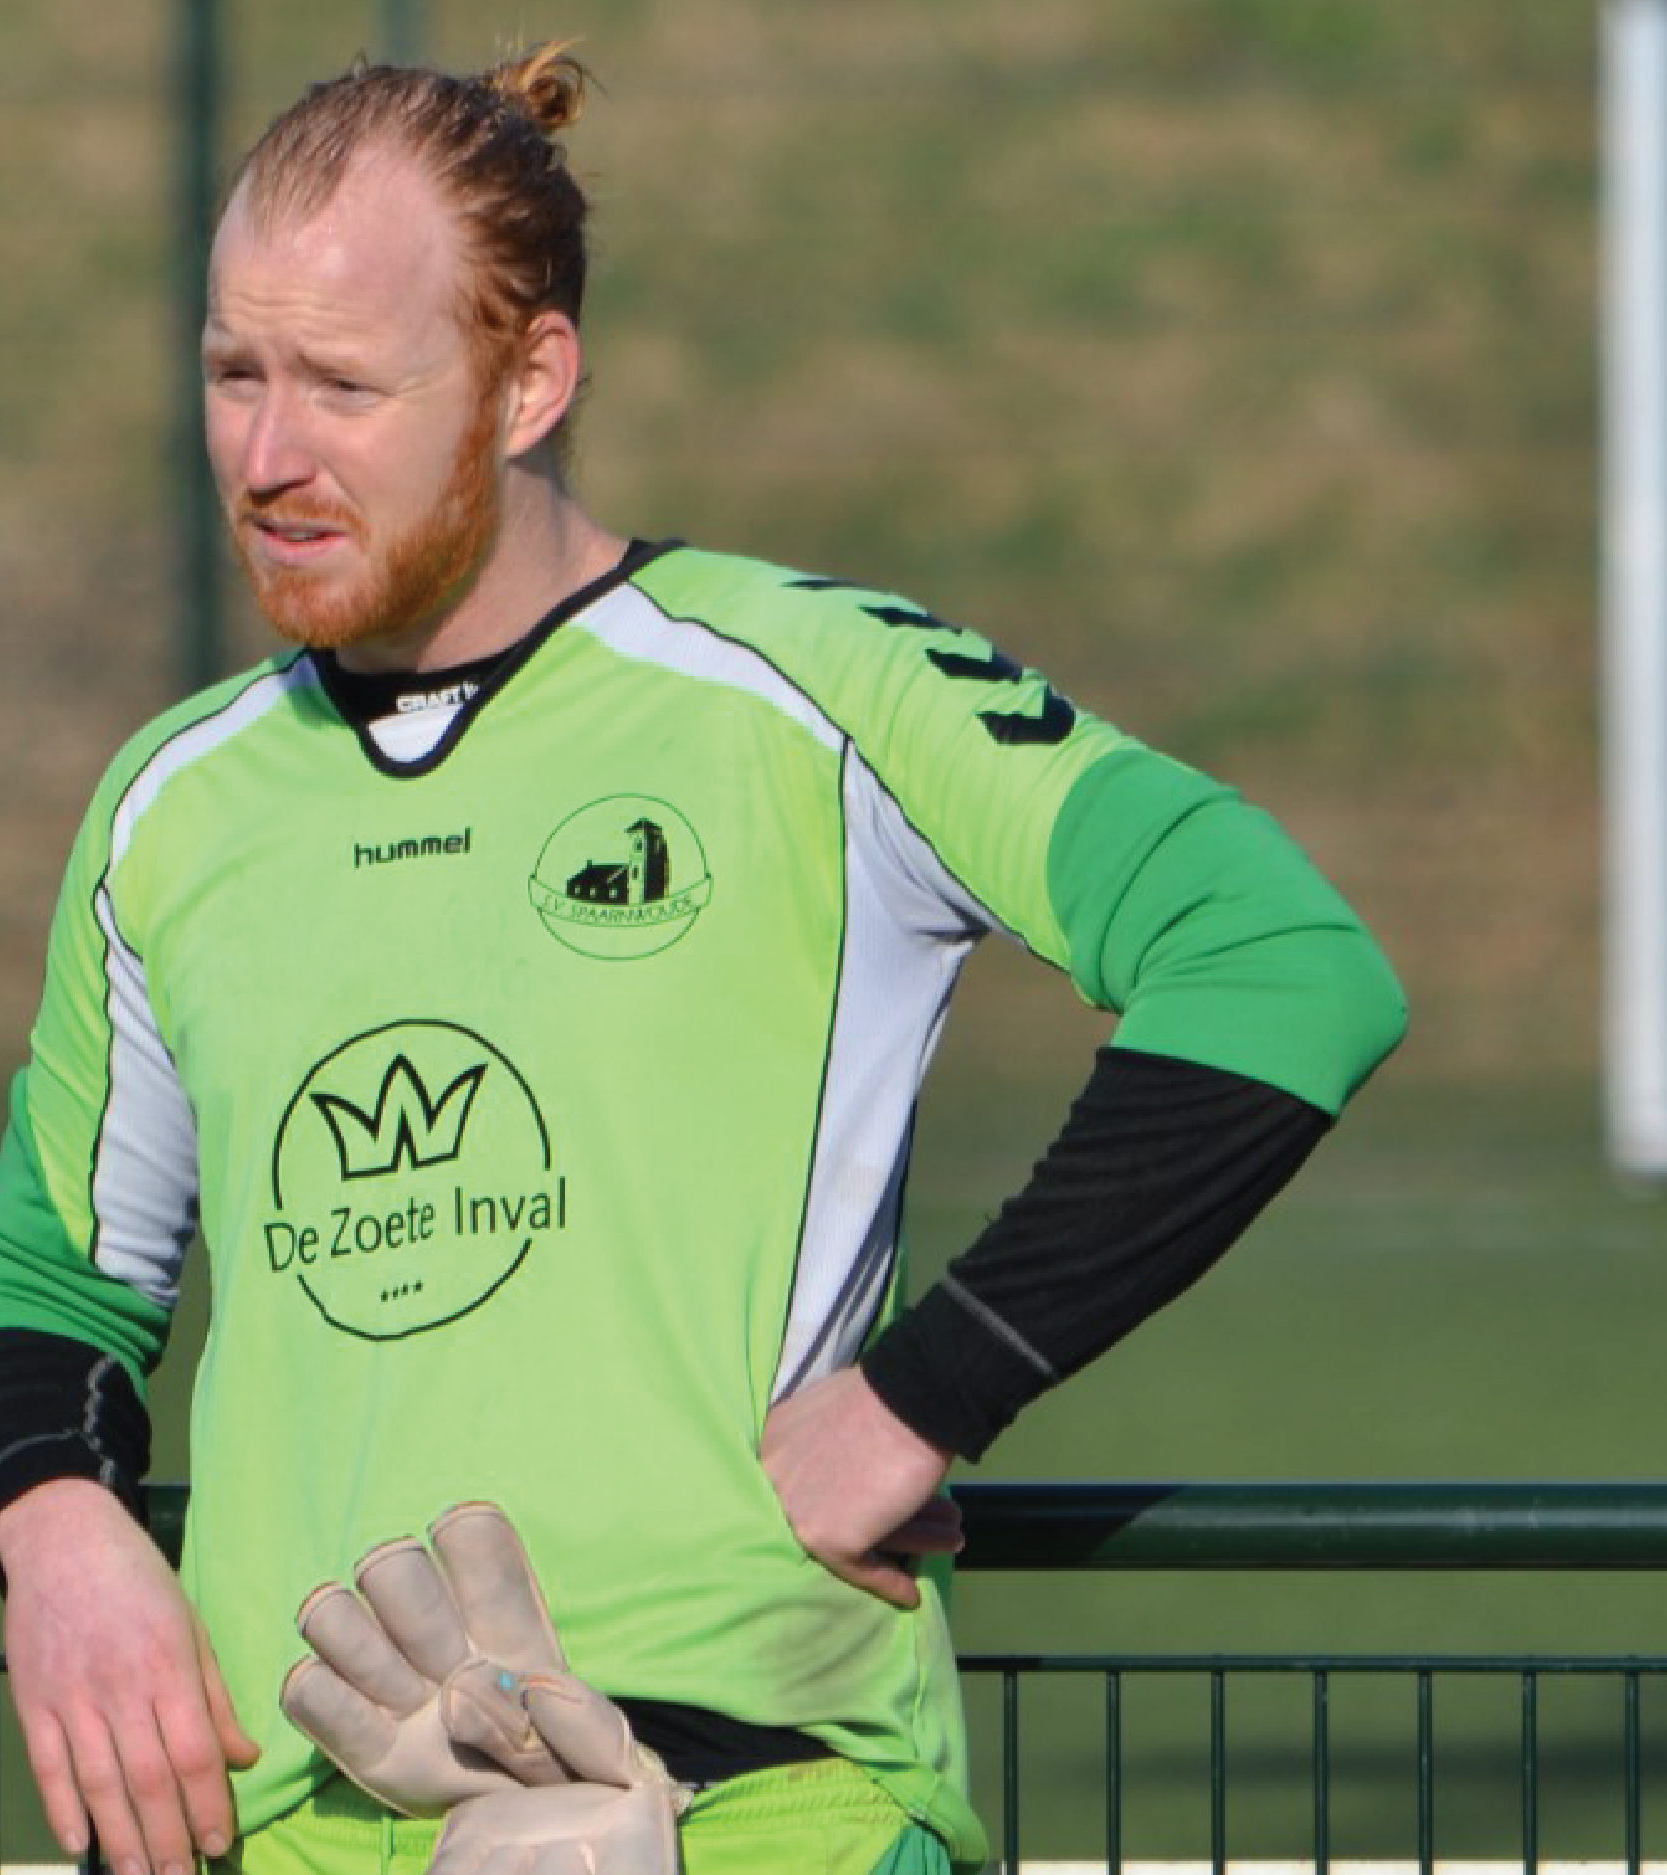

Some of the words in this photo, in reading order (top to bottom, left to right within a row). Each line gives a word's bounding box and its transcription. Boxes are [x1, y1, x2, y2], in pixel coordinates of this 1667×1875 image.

[353, 825, 472, 870] hummel
[263, 1221, 319, 1274] De
[330, 1196, 437, 1259] Zoete
[454, 1175, 566, 1236] Inval
